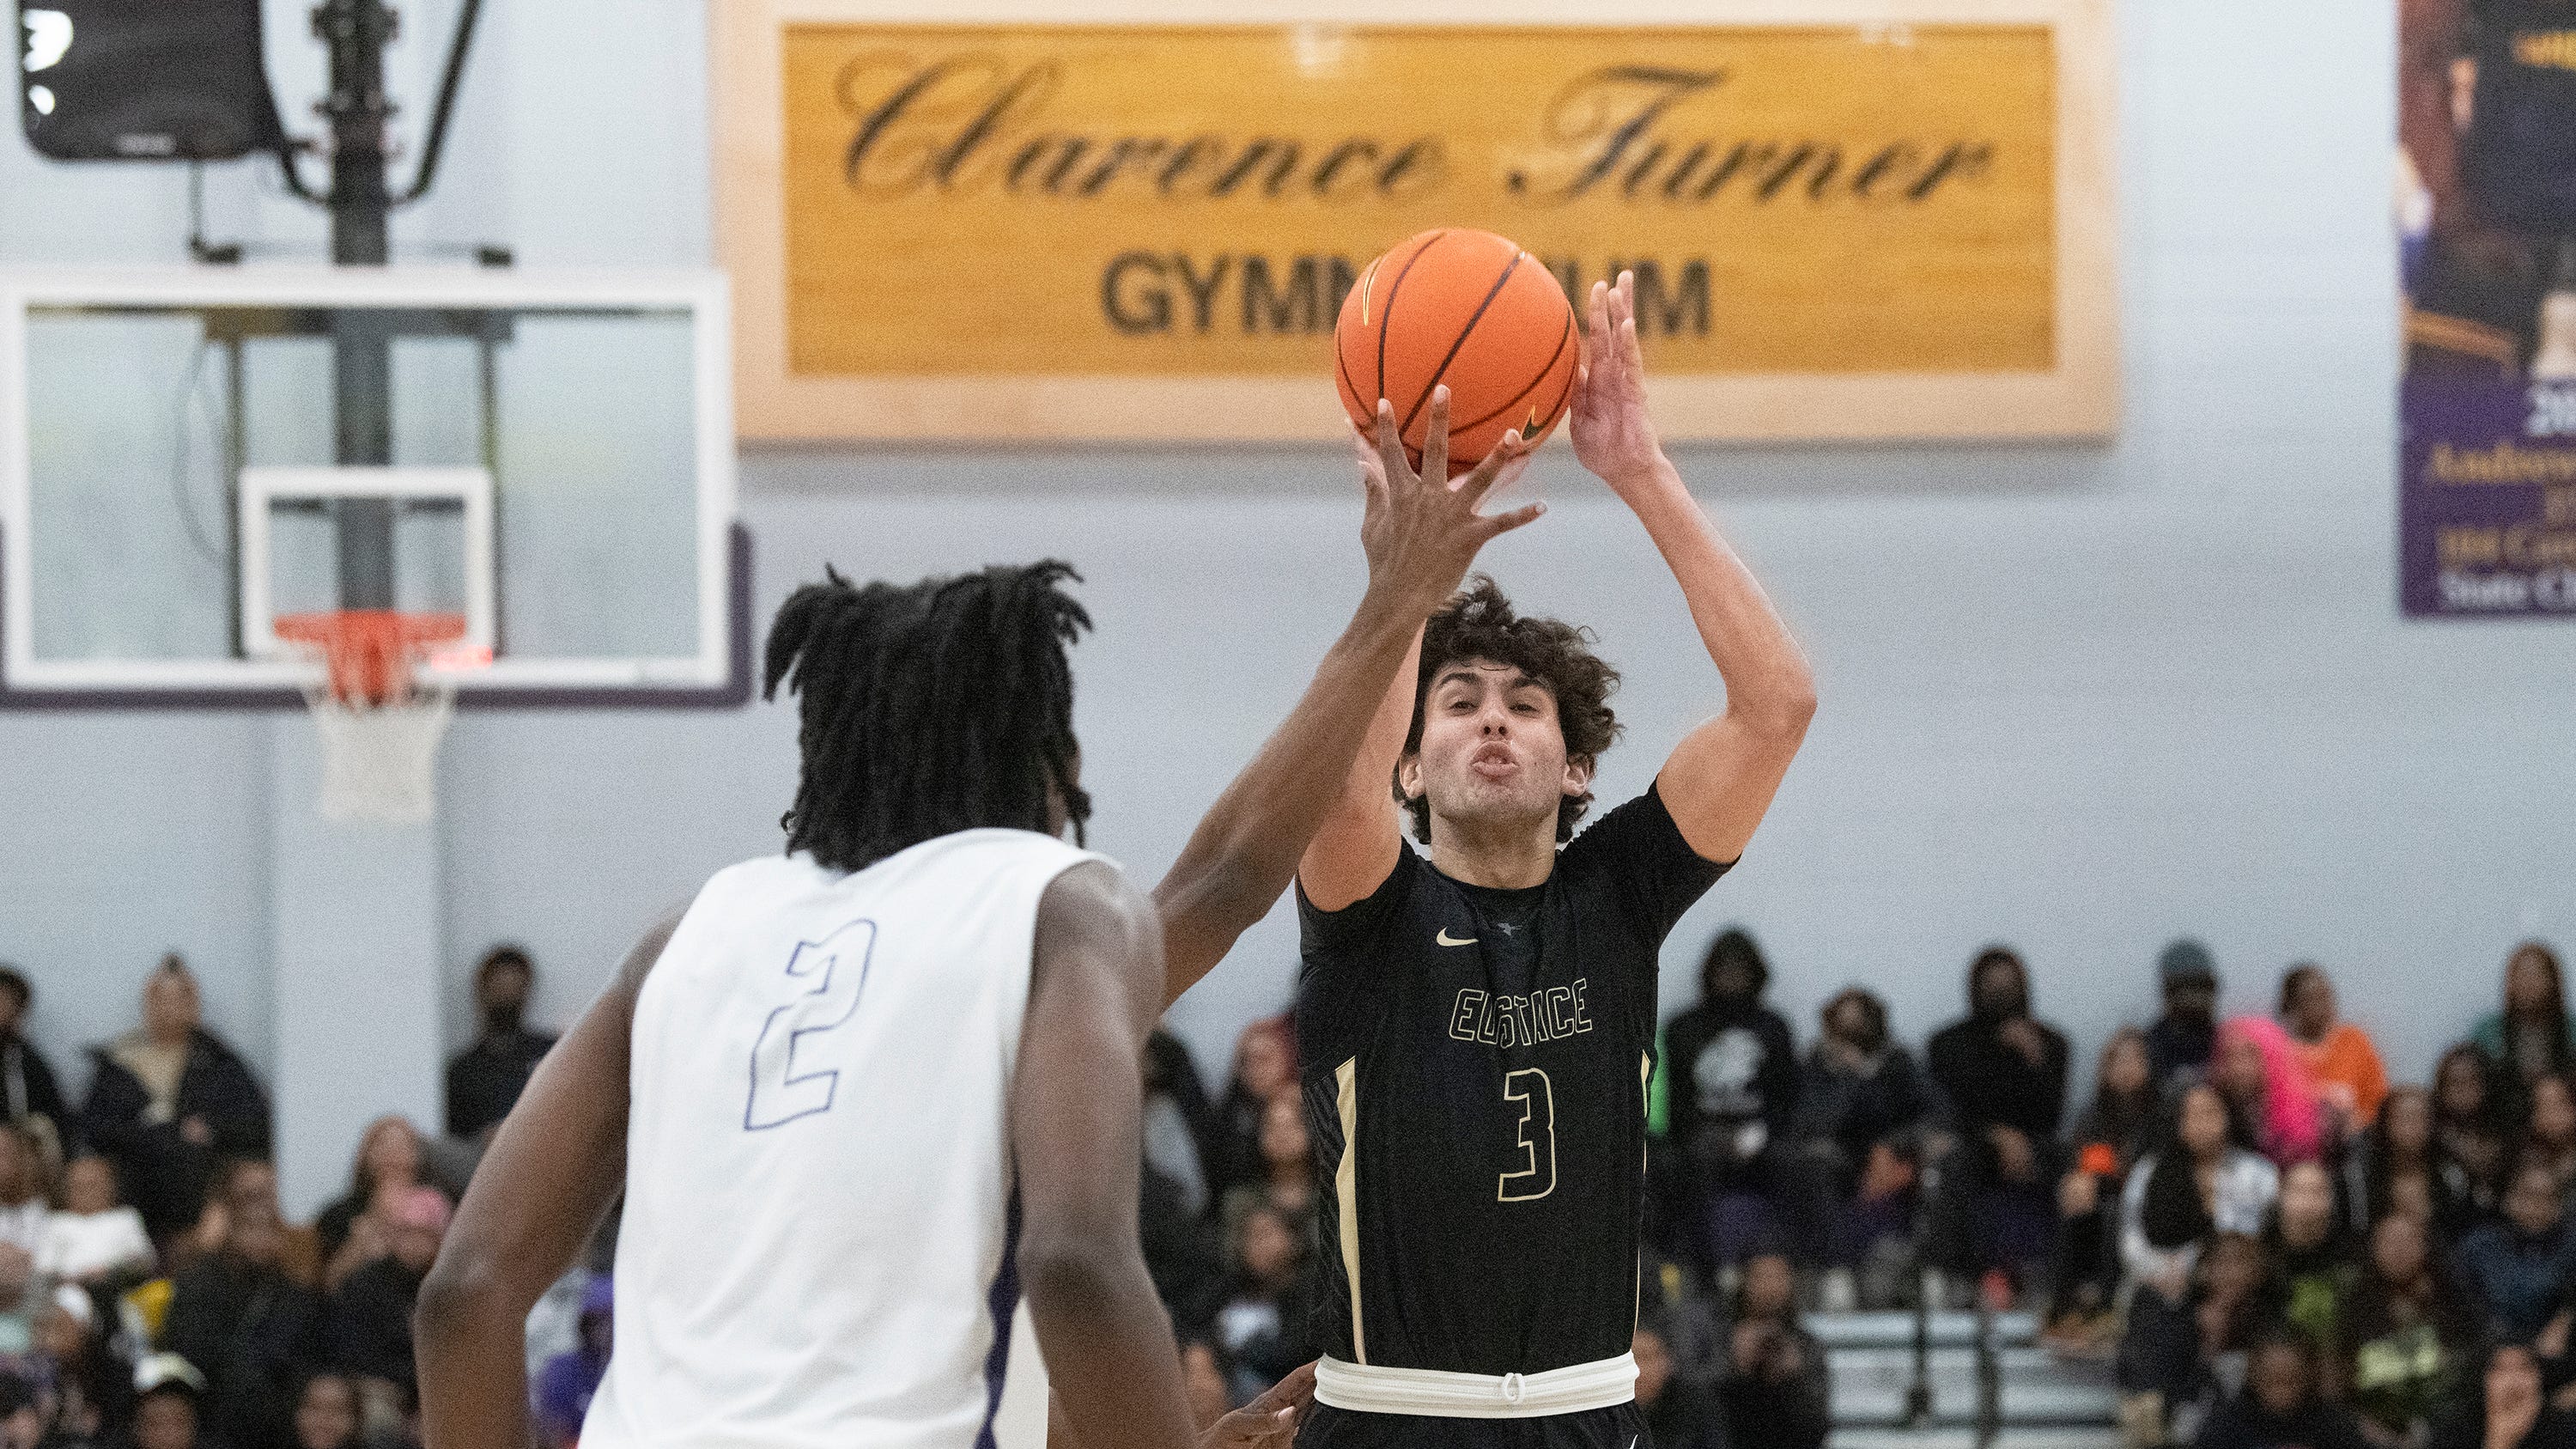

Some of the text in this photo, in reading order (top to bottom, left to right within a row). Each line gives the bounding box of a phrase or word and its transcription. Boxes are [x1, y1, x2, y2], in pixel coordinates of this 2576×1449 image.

[833, 48, 1997, 206] Clarence Turner
[1101, 251, 1711, 338] GYMUM
[744, 916, 877, 1131] 2
[1498, 1067, 1556, 1202] 3
